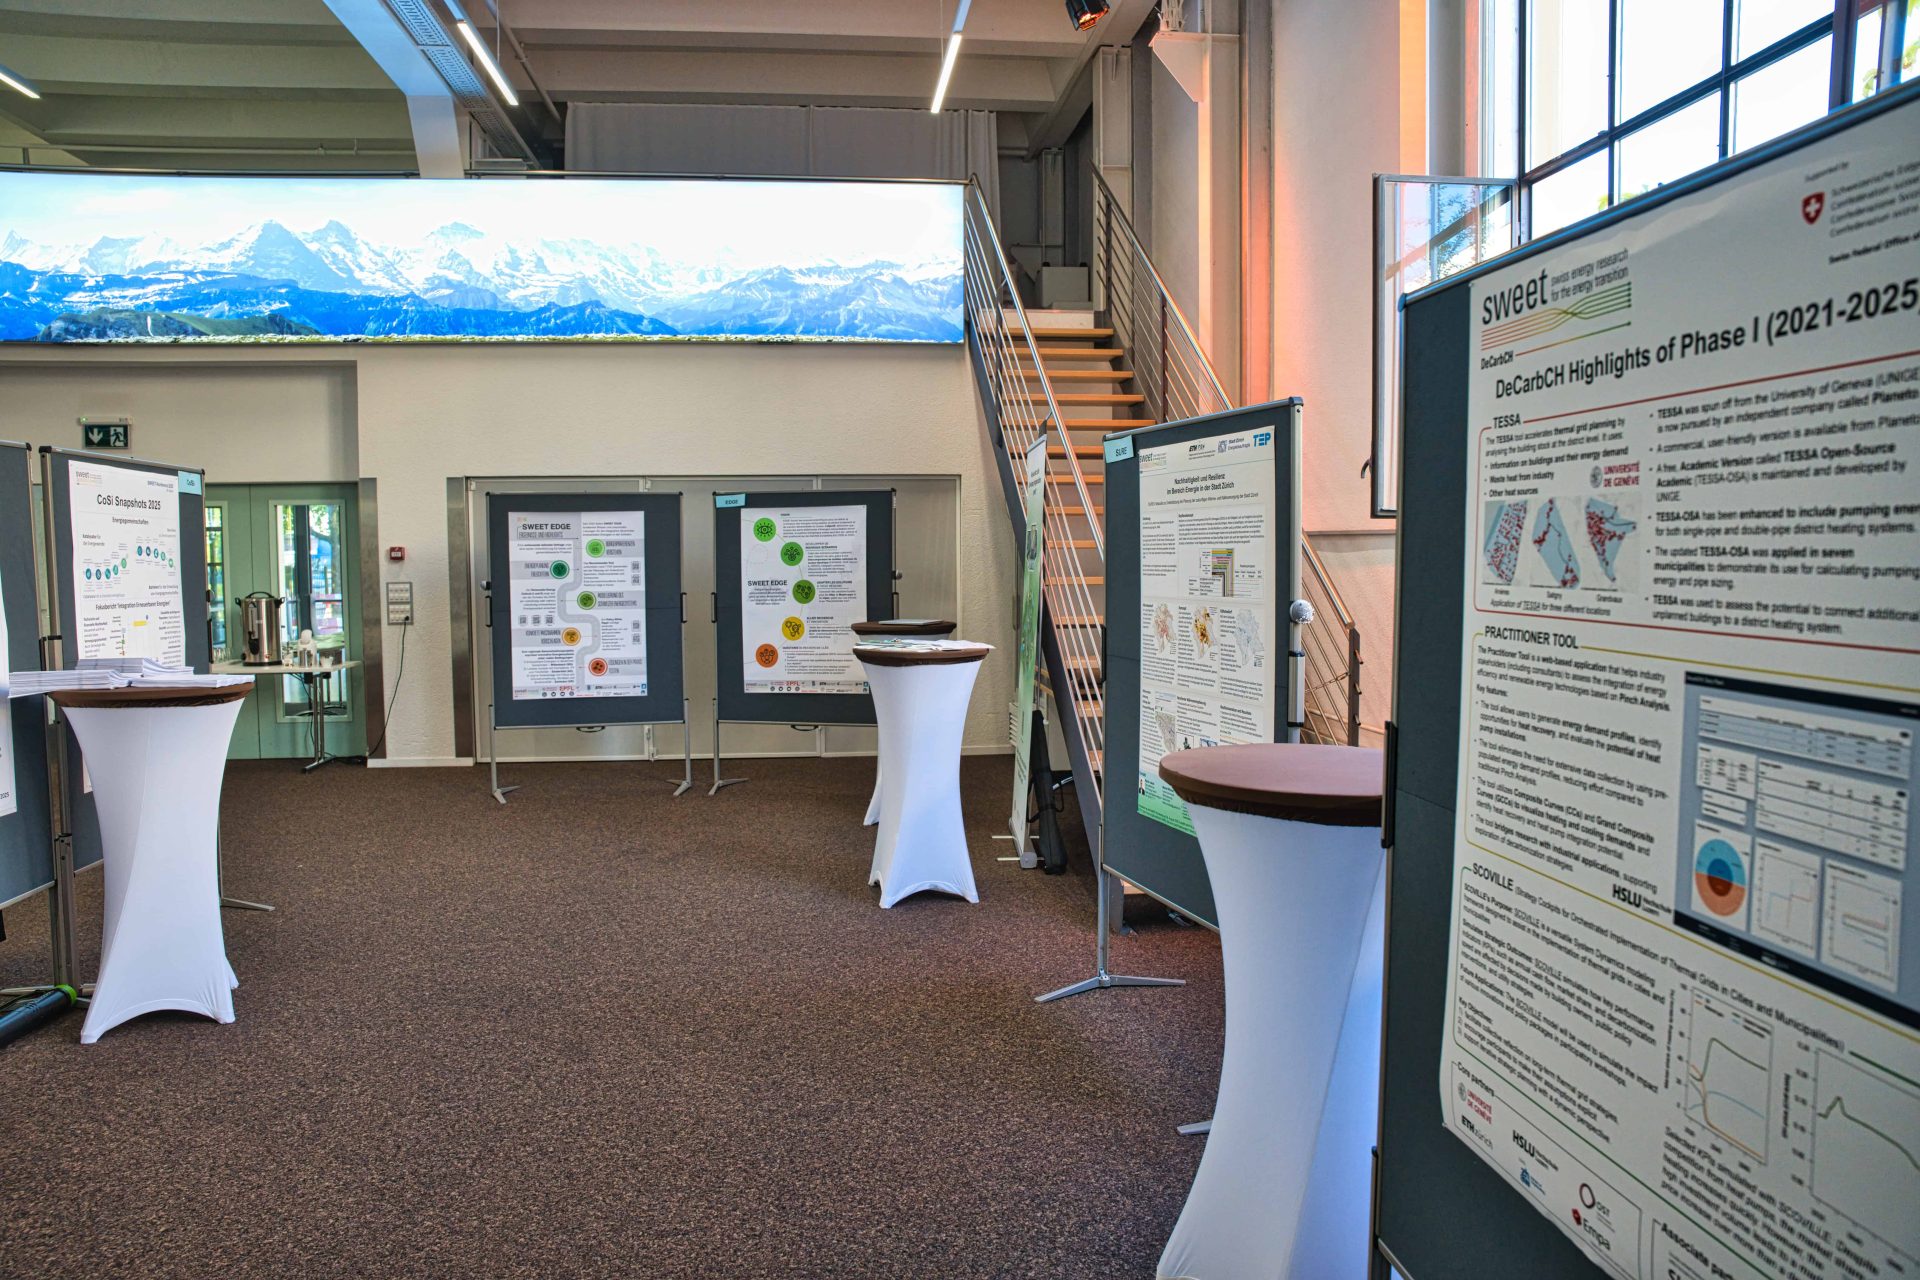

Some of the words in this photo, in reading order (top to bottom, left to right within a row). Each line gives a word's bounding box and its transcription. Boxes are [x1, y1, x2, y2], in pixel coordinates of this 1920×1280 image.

[1571, 263, 1594, 280] energy
[1596, 248, 1628, 271] research
[1572, 280, 1593, 296] energy
[1595, 266, 1628, 287] transition
[1482, 269, 1548, 325] sweet
[1496, 364, 1564, 398] DeCarbCH
[1569, 347, 1650, 385] Highlights
[1656, 336, 1676, 363] of
[1681, 326, 1746, 358] Phase
[1752, 316, 1759, 343] I
[1767, 277, 1920, 346] (2021-2025
[1493, 414, 1521, 429] TESSA
[1253, 432, 1271, 447] TEP
[1496, 434, 1513, 443] TESSA
[1115, 447, 1127, 457] SURE
[1490, 459, 1519, 469] Information
[1529, 456, 1553, 465] buildings
[1602, 447, 1628, 457] demand
[1784, 449, 1818, 462] TESSA
[97, 494, 113, 505] CoSi
[115, 495, 147, 510] Snapshots
[149, 500, 161, 510] 2025
[1485, 626, 1550, 646] PRACTITIONER
[1553, 633, 1578, 649] TOOL
[1574, 661, 1607, 672] application
[1584, 724, 1609, 736] demand
[1618, 822, 1654, 842] Composite
[1472, 862, 1514, 892] SCOVILLE
[1612, 884, 1641, 908] HSLU
[1471, 1074, 1495, 1097] partners
[1462, 1115, 1474, 1132] ETH
[1512, 1130, 1535, 1157] HSLU
[1583, 1218, 1611, 1251] Empa
[1661, 1222, 1709, 1267] Associate
